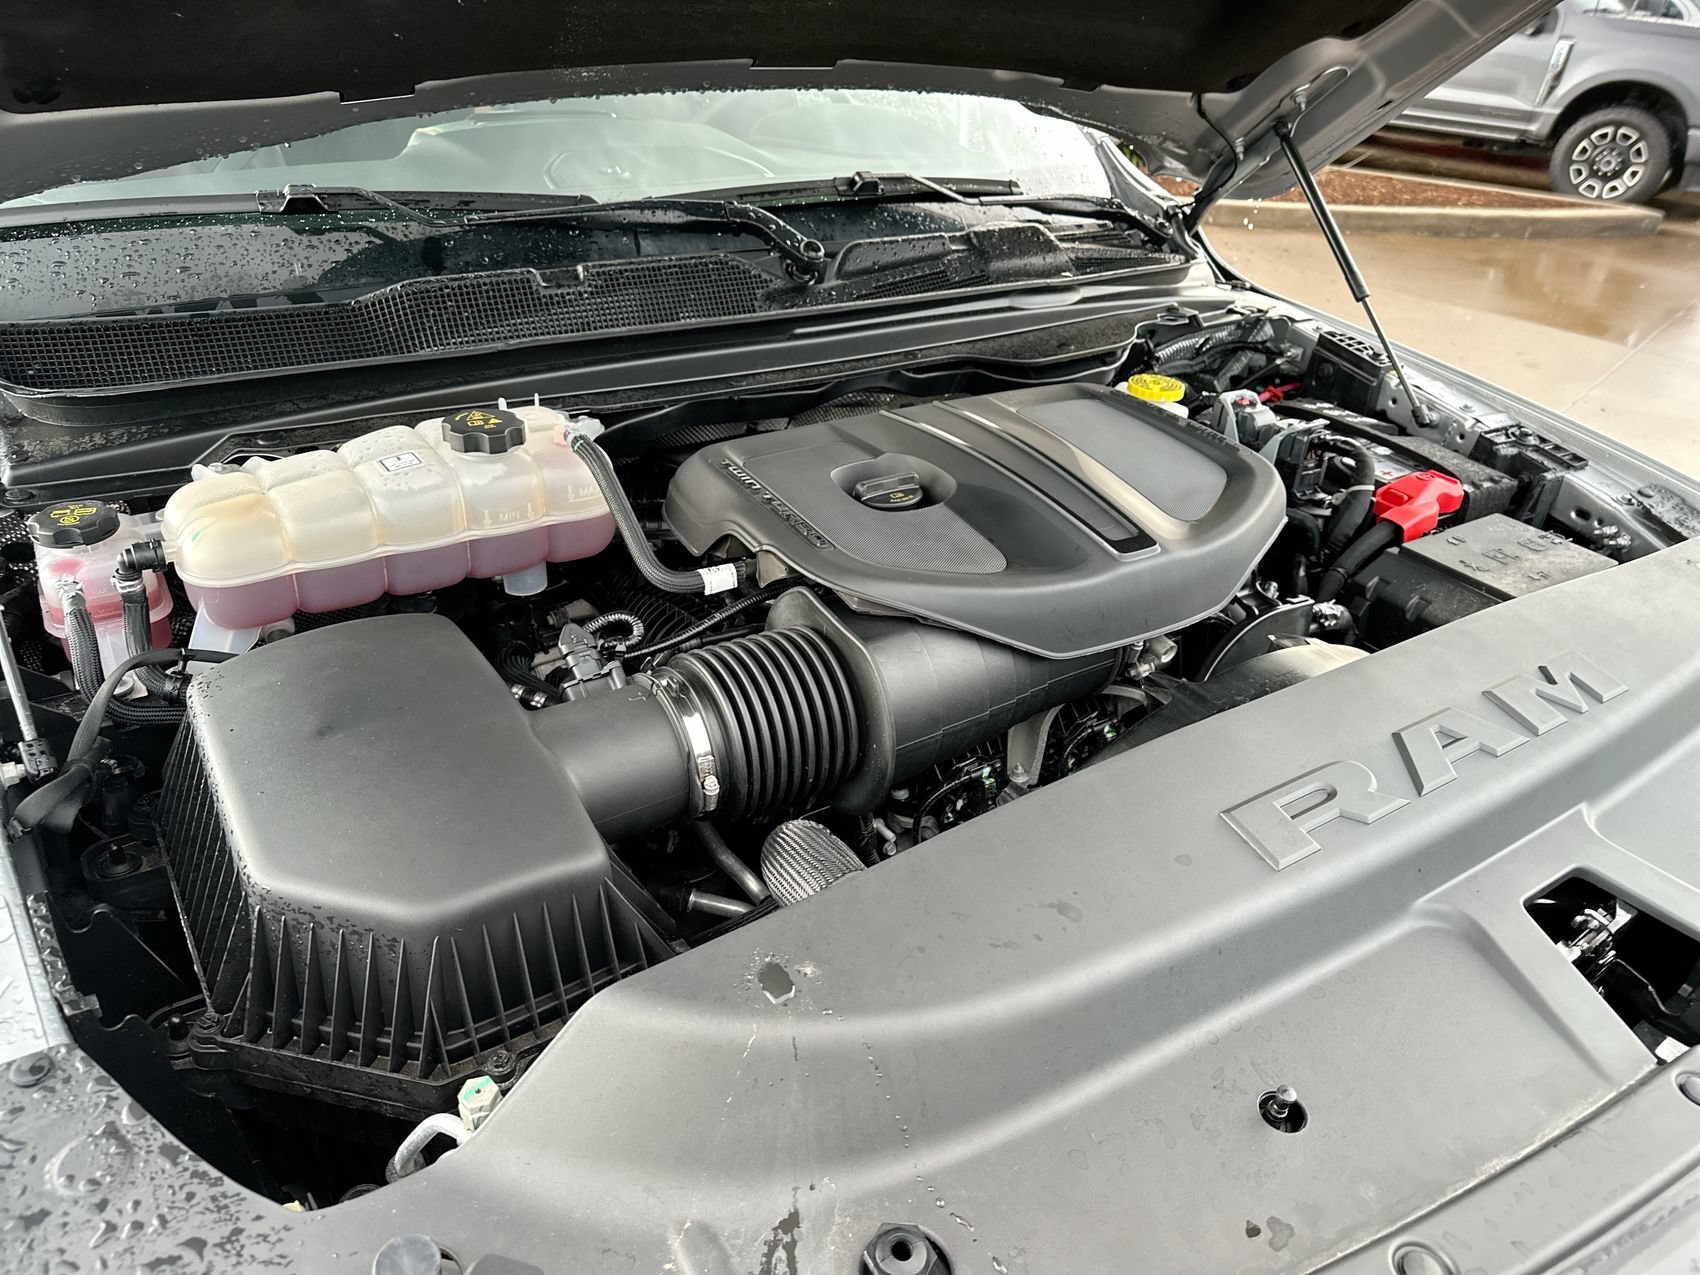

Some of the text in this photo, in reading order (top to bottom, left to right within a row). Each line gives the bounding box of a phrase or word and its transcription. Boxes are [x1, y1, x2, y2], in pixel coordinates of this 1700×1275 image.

[720, 458, 762, 490] TWIN
[499, 510, 521, 521] MIN
[1218, 648, 1630, 872] RAM
